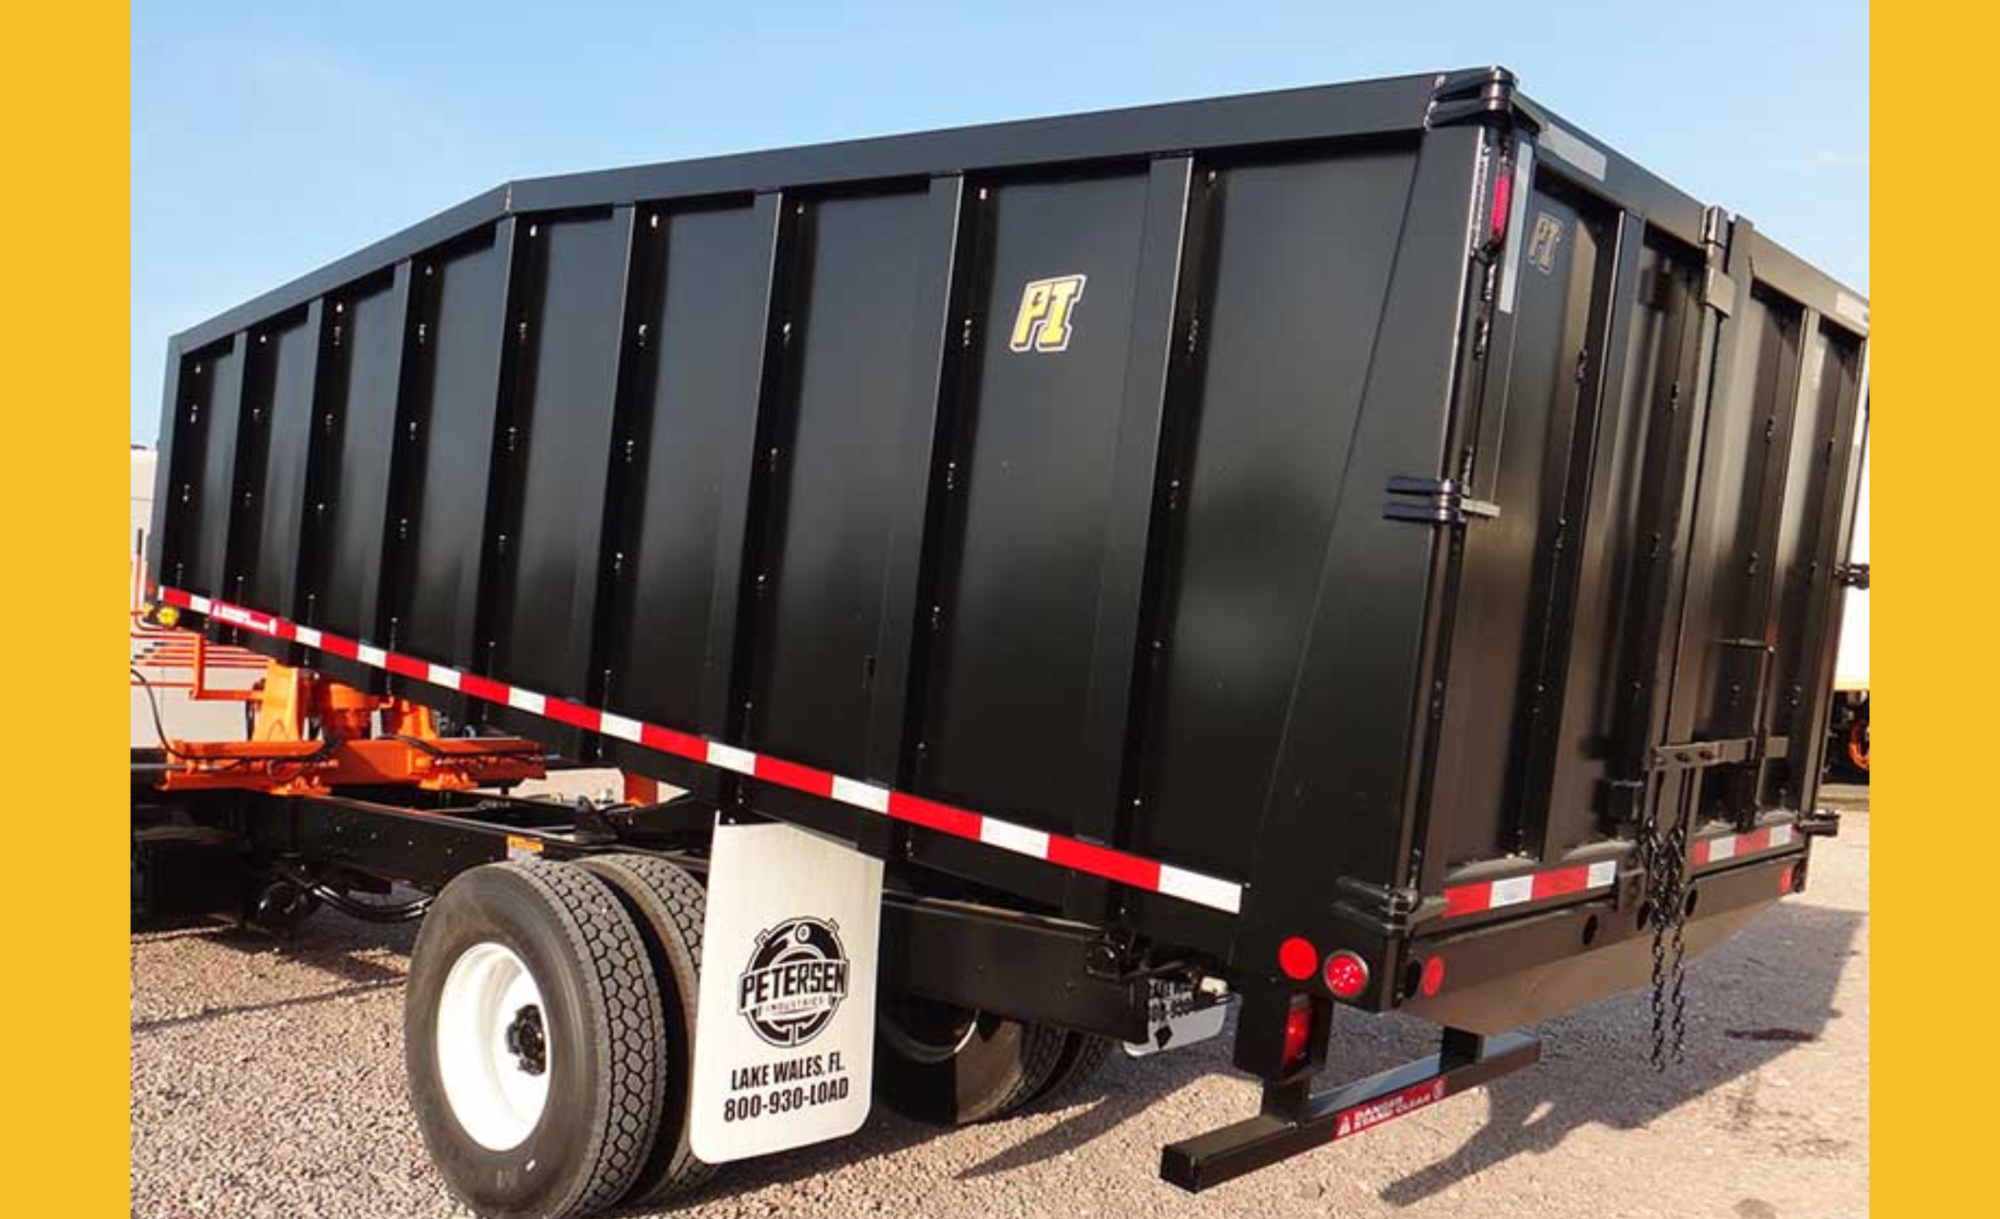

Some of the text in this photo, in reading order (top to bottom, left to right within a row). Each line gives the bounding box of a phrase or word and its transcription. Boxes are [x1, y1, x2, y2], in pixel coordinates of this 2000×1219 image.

[1528, 211, 1563, 274] PI
[1010, 275, 1086, 351] PI
[741, 962, 847, 1010] PETERSEN
[731, 1065, 769, 1091] LAKE
[828, 1050, 846, 1073] FL.
[724, 1077, 849, 1122] 800-930-LOAD
